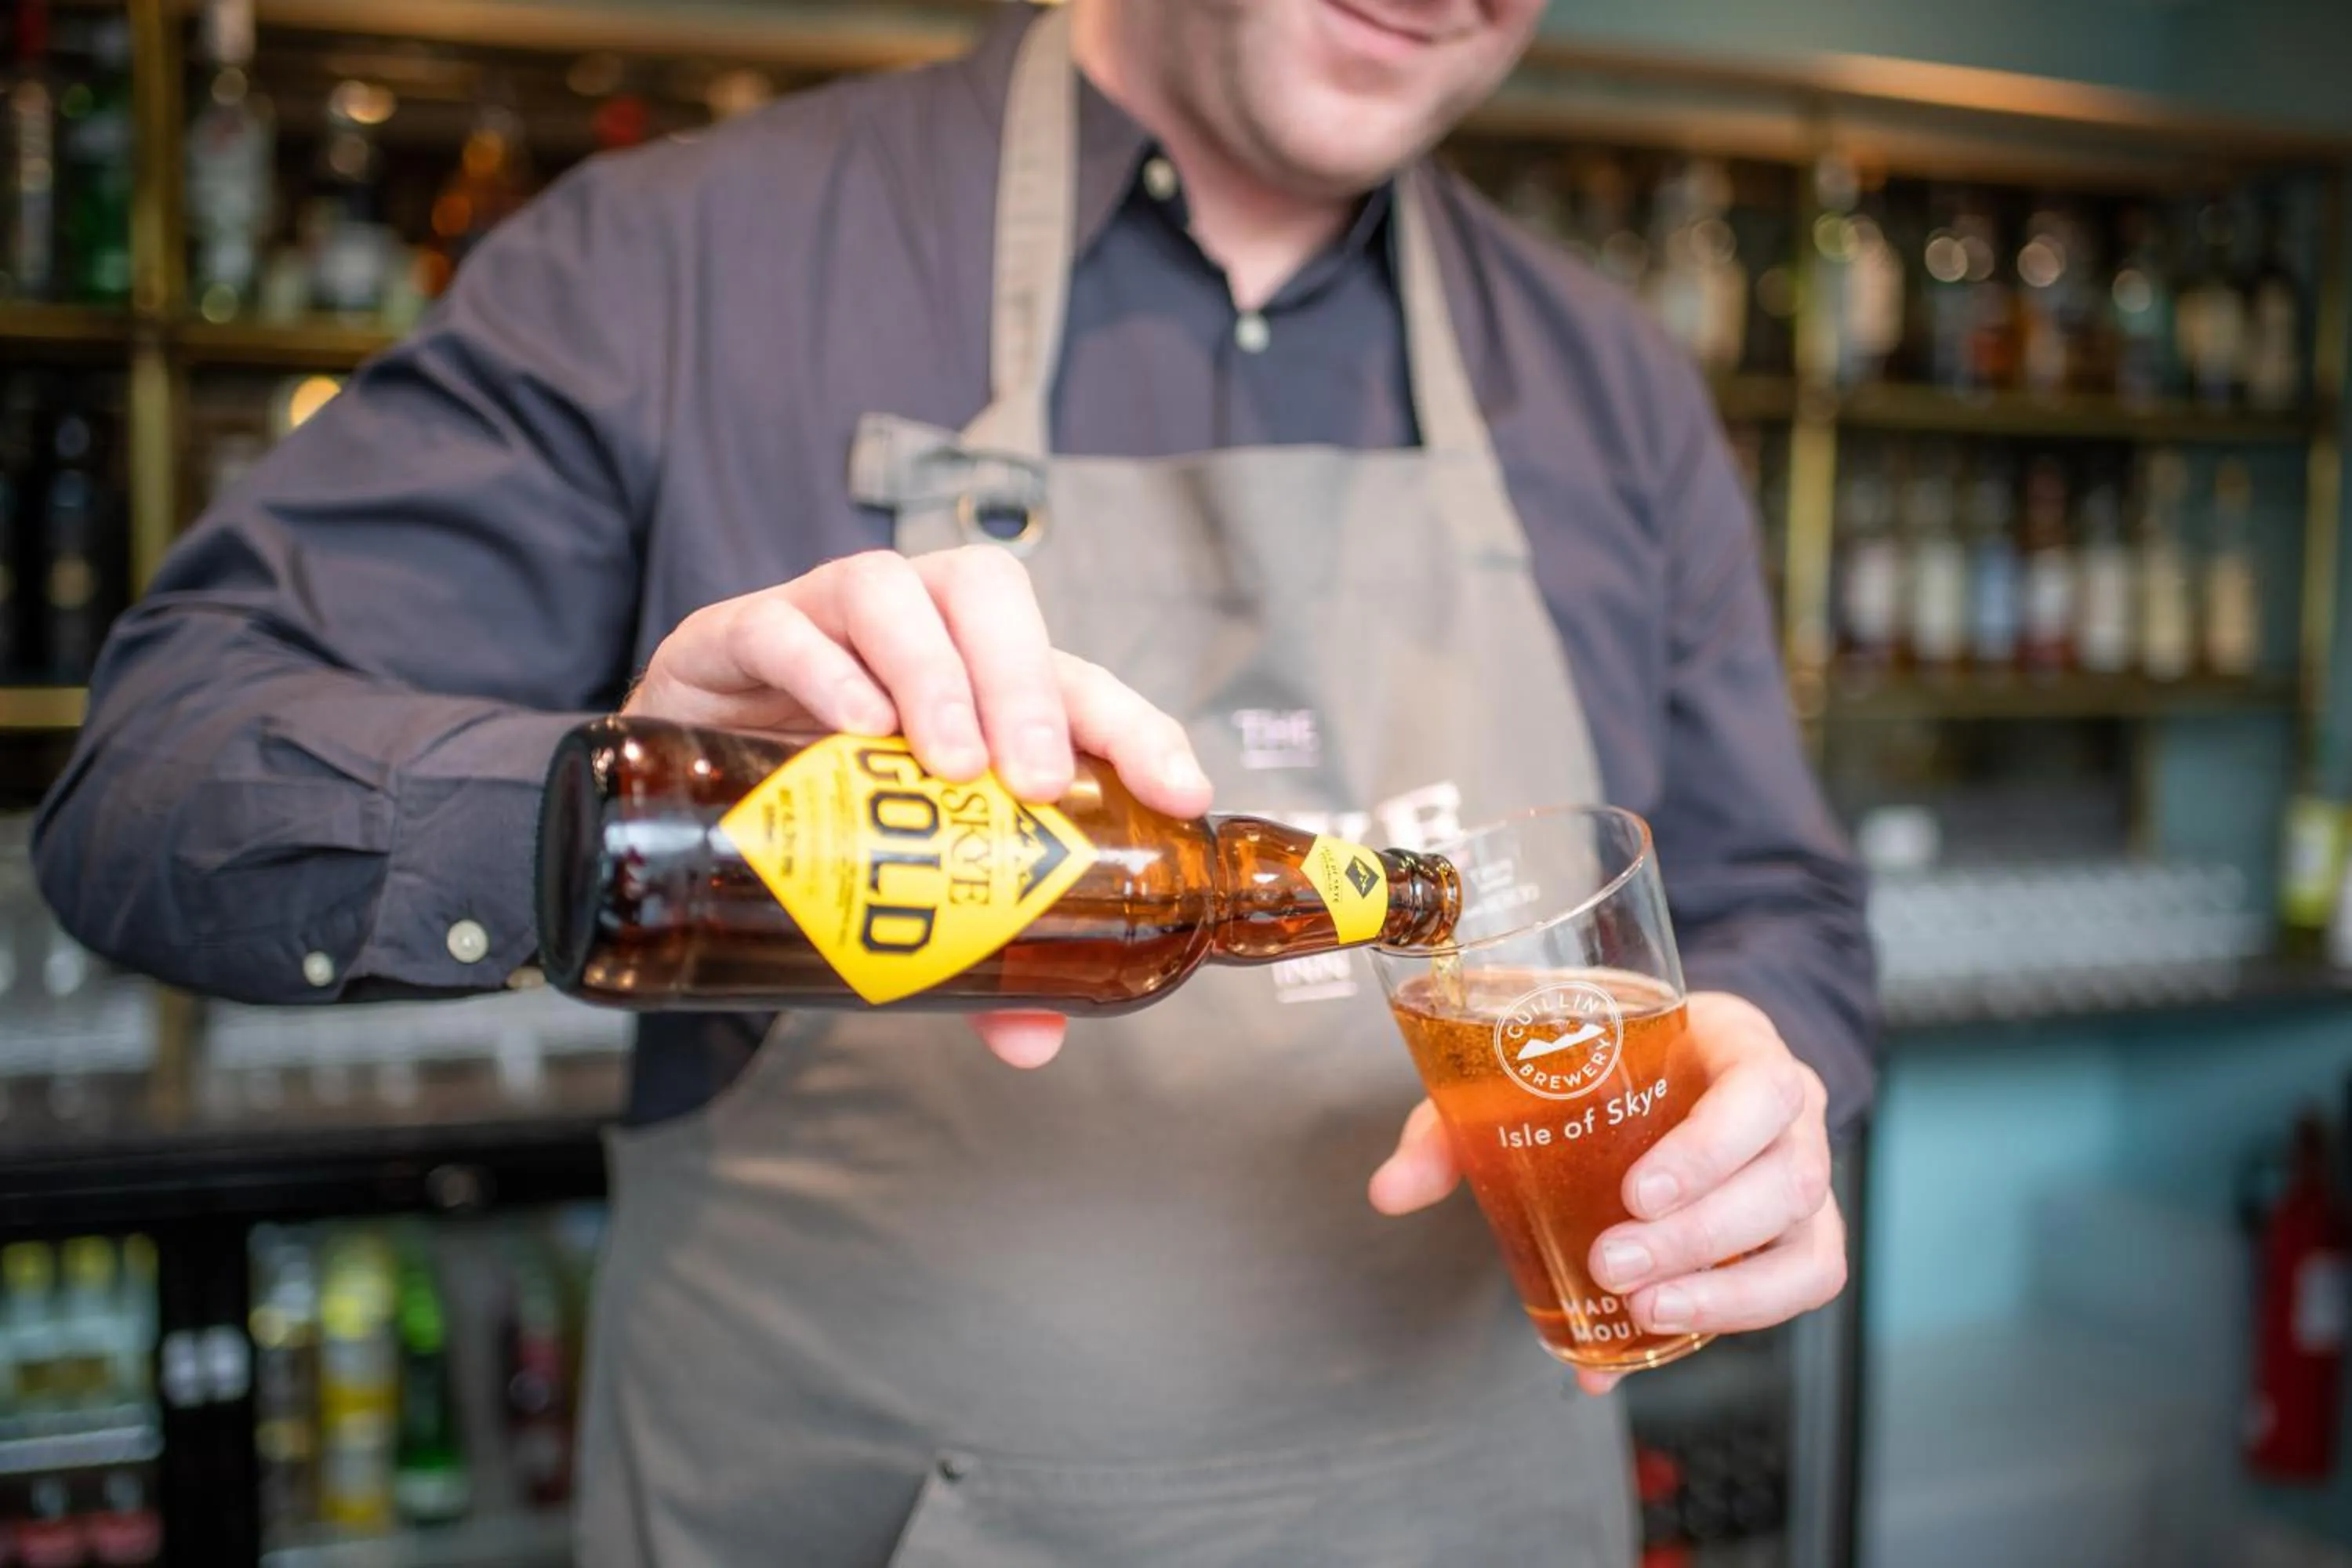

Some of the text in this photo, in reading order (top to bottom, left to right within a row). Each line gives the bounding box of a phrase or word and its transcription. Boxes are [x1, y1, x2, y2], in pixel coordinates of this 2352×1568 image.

[857, 749, 941, 955] GOLD
[942, 787, 990, 906] SKYE
[1506, 993, 1600, 1040] CUILLIN
[1518, 1037, 1611, 1090] BREWERY
[1498, 1078, 1668, 1149] Isle of Skye
[1560, 1294, 1628, 1316] MAD
[1571, 1321, 1642, 1345] MOU
